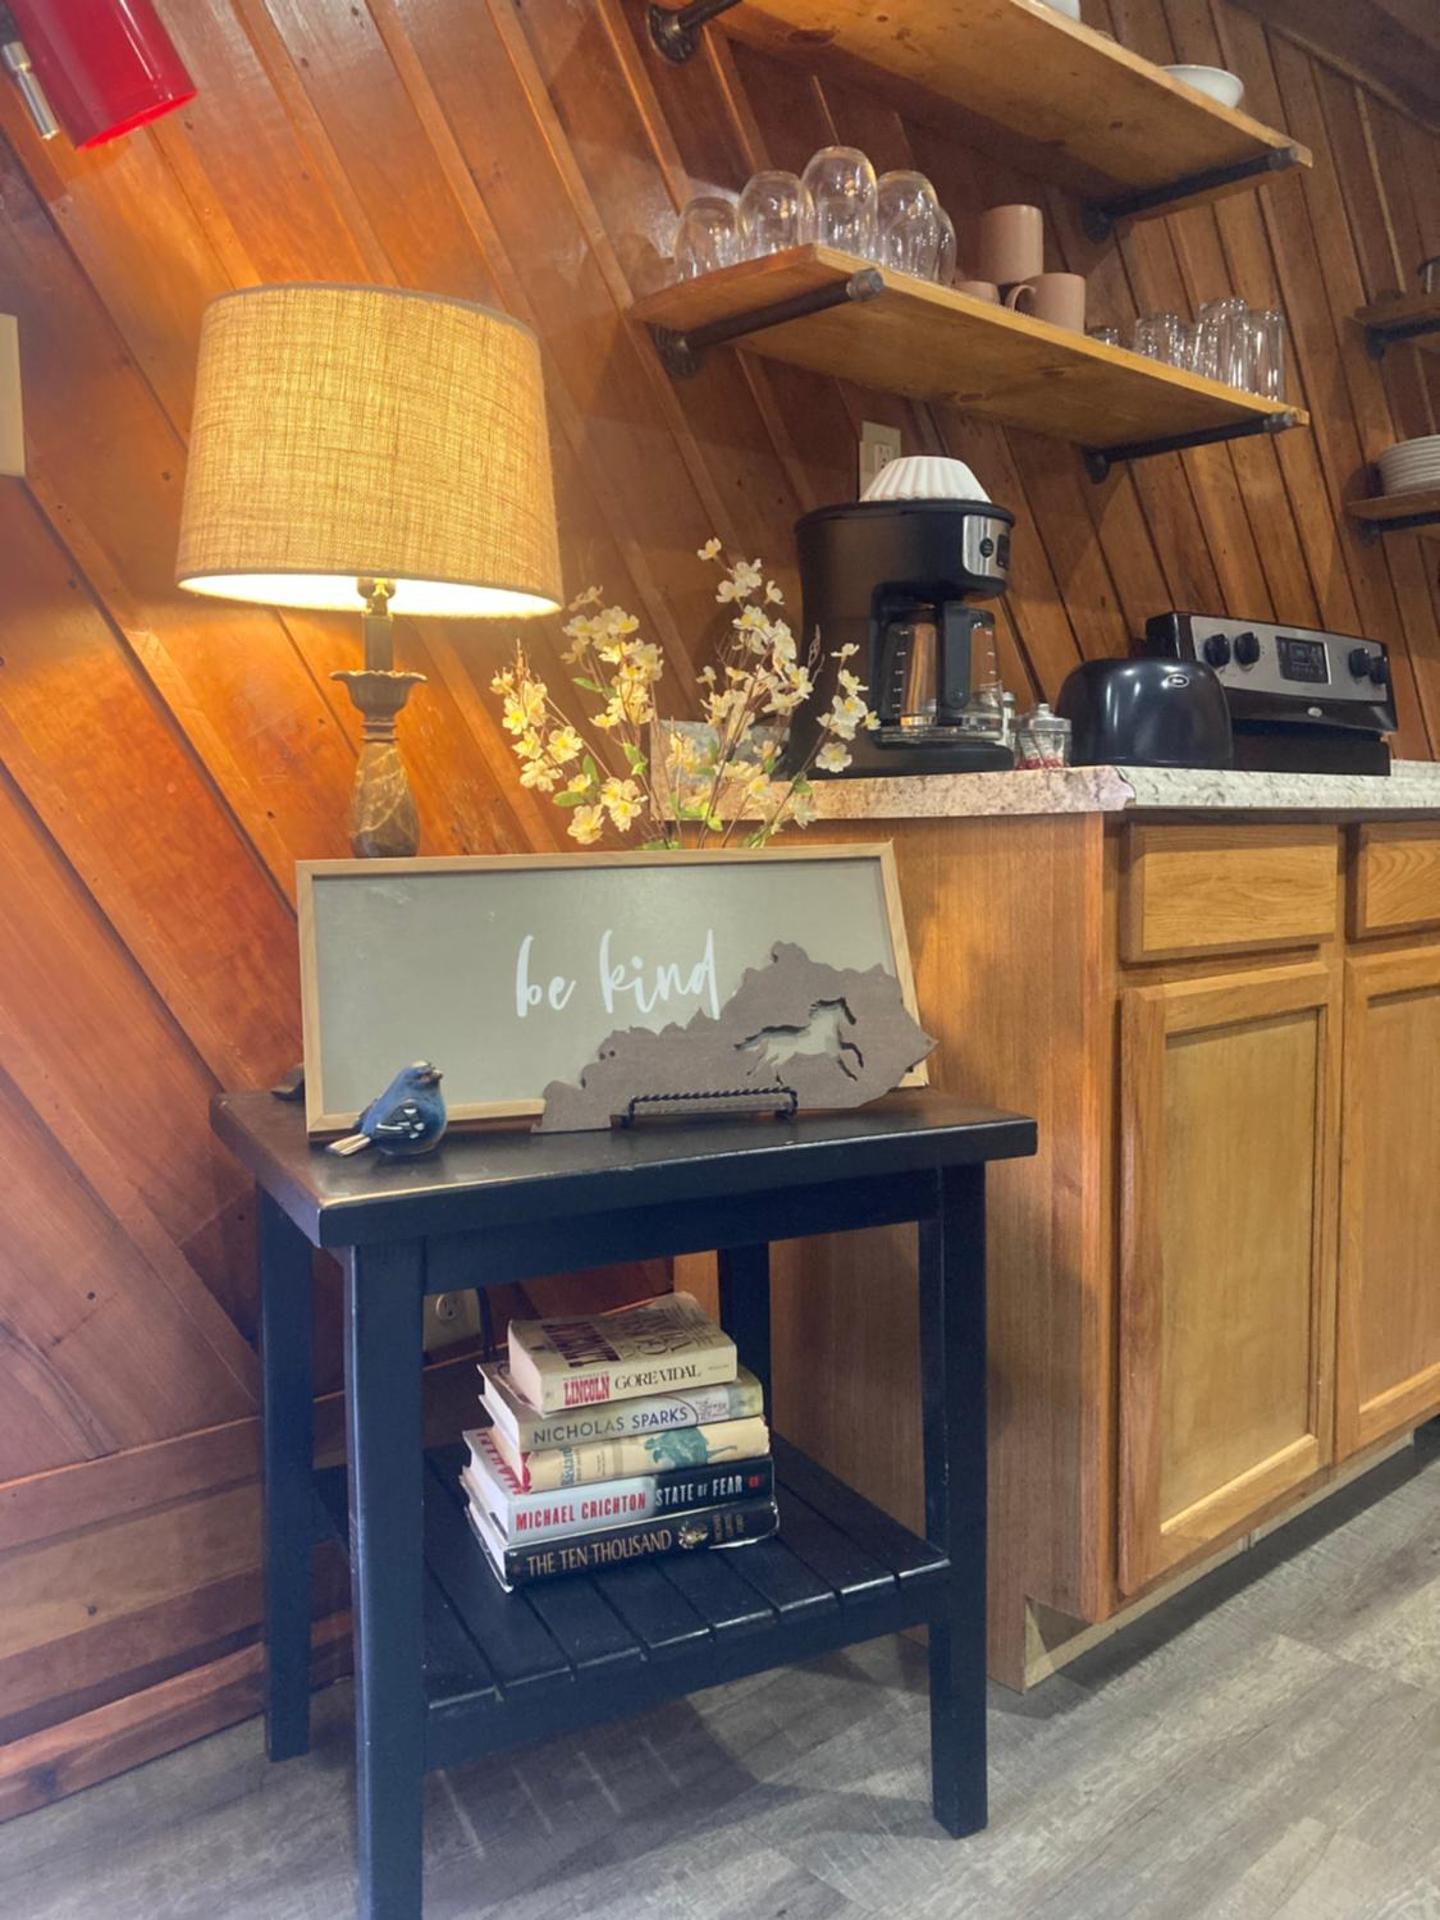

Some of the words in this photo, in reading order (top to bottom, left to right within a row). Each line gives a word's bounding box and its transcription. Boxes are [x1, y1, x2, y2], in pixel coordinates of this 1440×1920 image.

[516, 934, 576, 1018] be
[600, 929, 720, 1020] kind
[564, 1375, 611, 1406] LINCOLN
[614, 1372, 658, 1390] GORE
[657, 1364, 701, 1383] VIDAL
[533, 1417, 625, 1444] NICHOLAS
[632, 1408, 689, 1430] SPARKS
[515, 1504, 576, 1531] MICHAEL
[581, 1492, 647, 1518] CRICHTON
[655, 1483, 694, 1506] STATE
[712, 1474, 744, 1497] FEAR
[527, 1550, 556, 1577] THE
[559, 1546, 589, 1570] TEN
[592, 1529, 673, 1564] THOUSAND
